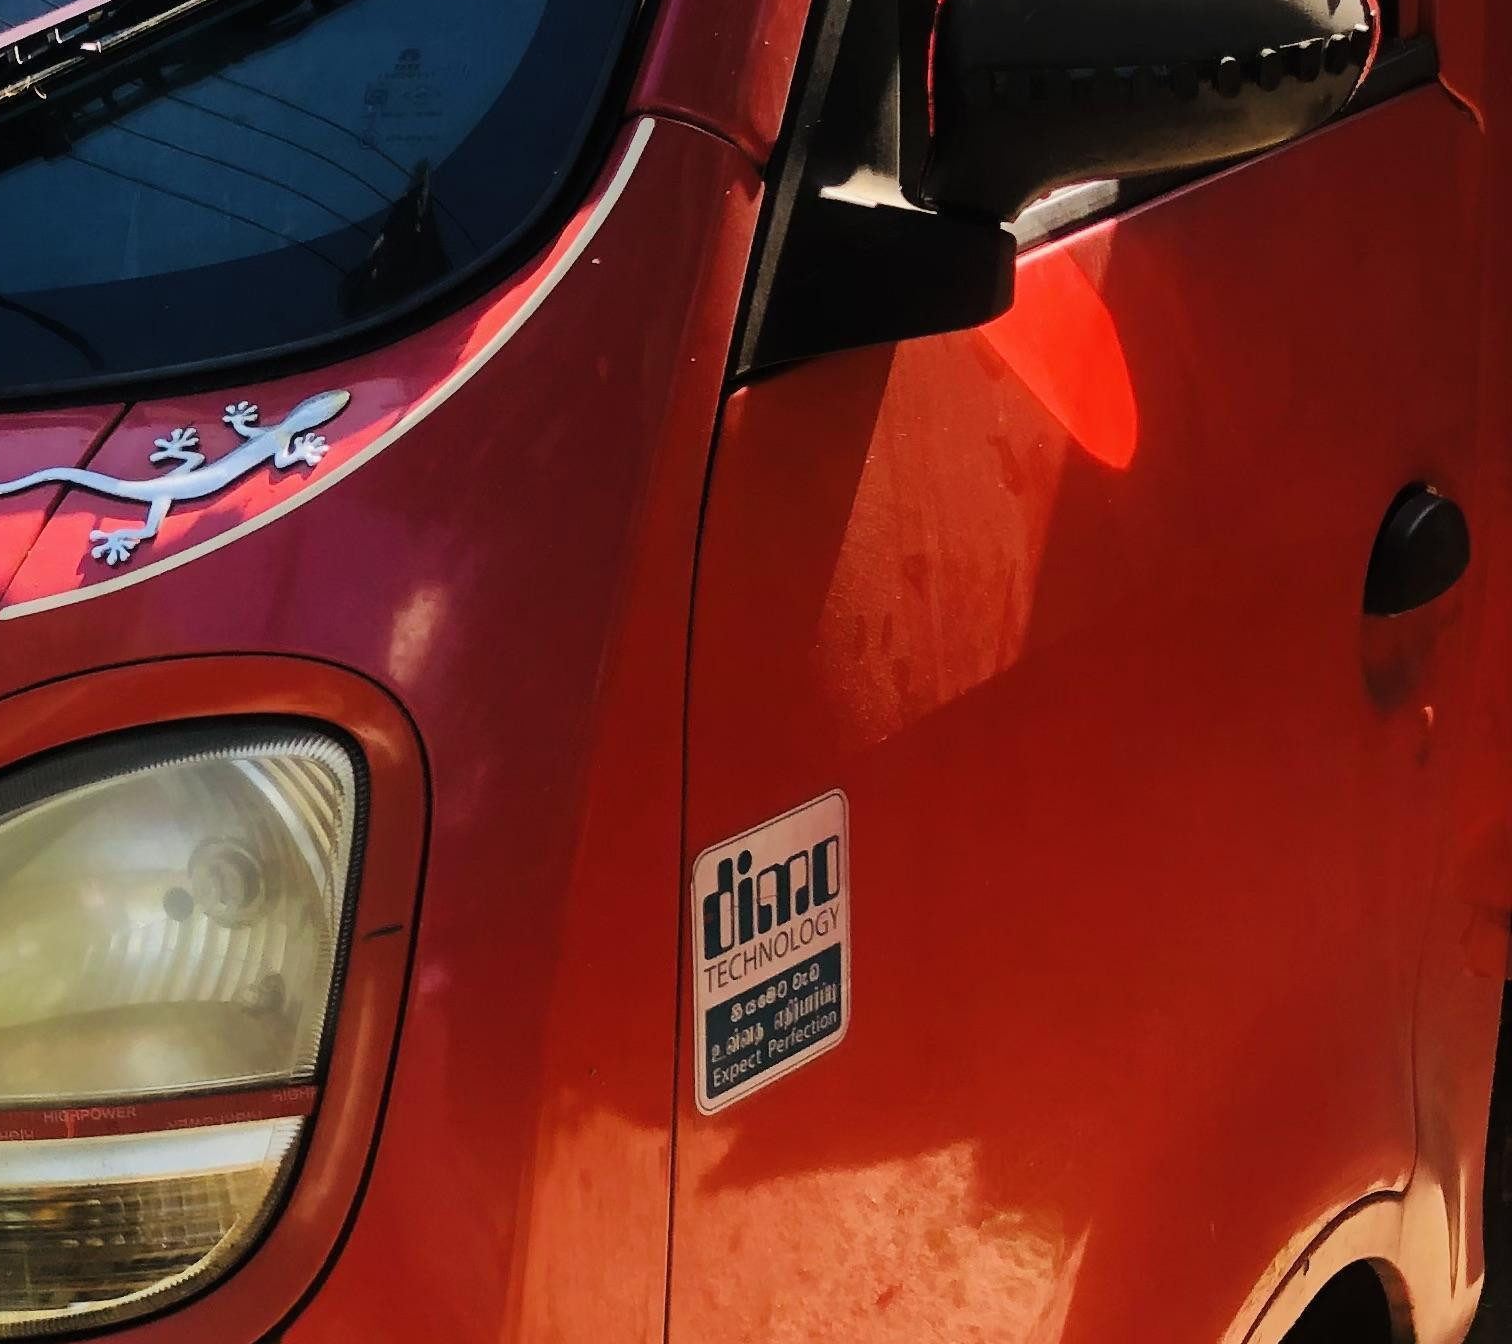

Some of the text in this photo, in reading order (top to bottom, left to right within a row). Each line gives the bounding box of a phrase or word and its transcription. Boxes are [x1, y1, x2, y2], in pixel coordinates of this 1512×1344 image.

[703, 835, 840, 960] dimo
[704, 907, 839, 993] TECHNOLOGY
[713, 1010, 838, 1088] Expect Perfection
[44, 1107, 137, 1122] HIGHPOWER
